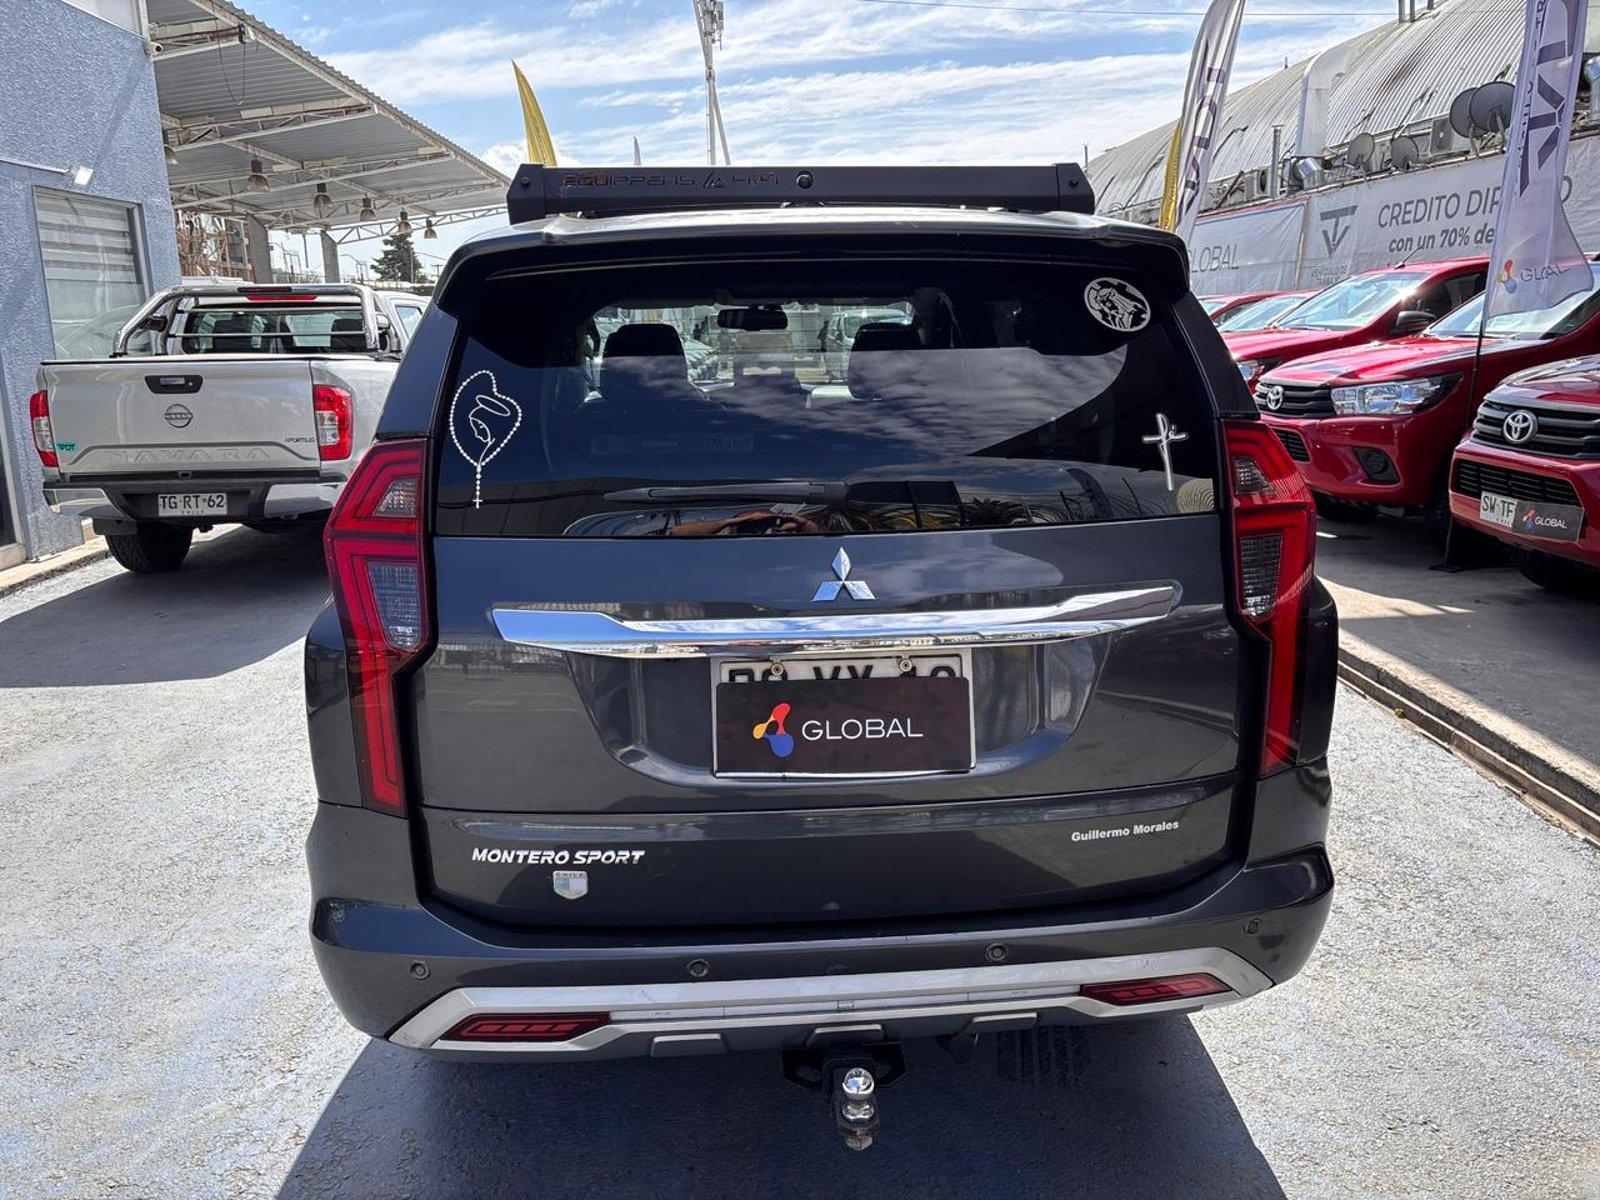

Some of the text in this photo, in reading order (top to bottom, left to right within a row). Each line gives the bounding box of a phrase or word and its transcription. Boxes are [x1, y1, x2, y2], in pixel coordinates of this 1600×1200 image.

[1378, 193, 1461, 228] CREDITO
[1389, 236, 1413, 253] con
[1417, 234, 1435, 250] un
[1440, 226, 1470, 248] 70%
[1188, 243, 1240, 273] LOBAL
[1534, 515, 1568, 530] GLOBAL
[801, 717, 924, 741] GLOBAL
[1071, 820, 1180, 842] Guillermo Morales
[471, 847, 645, 865] MONTERO SPORT
